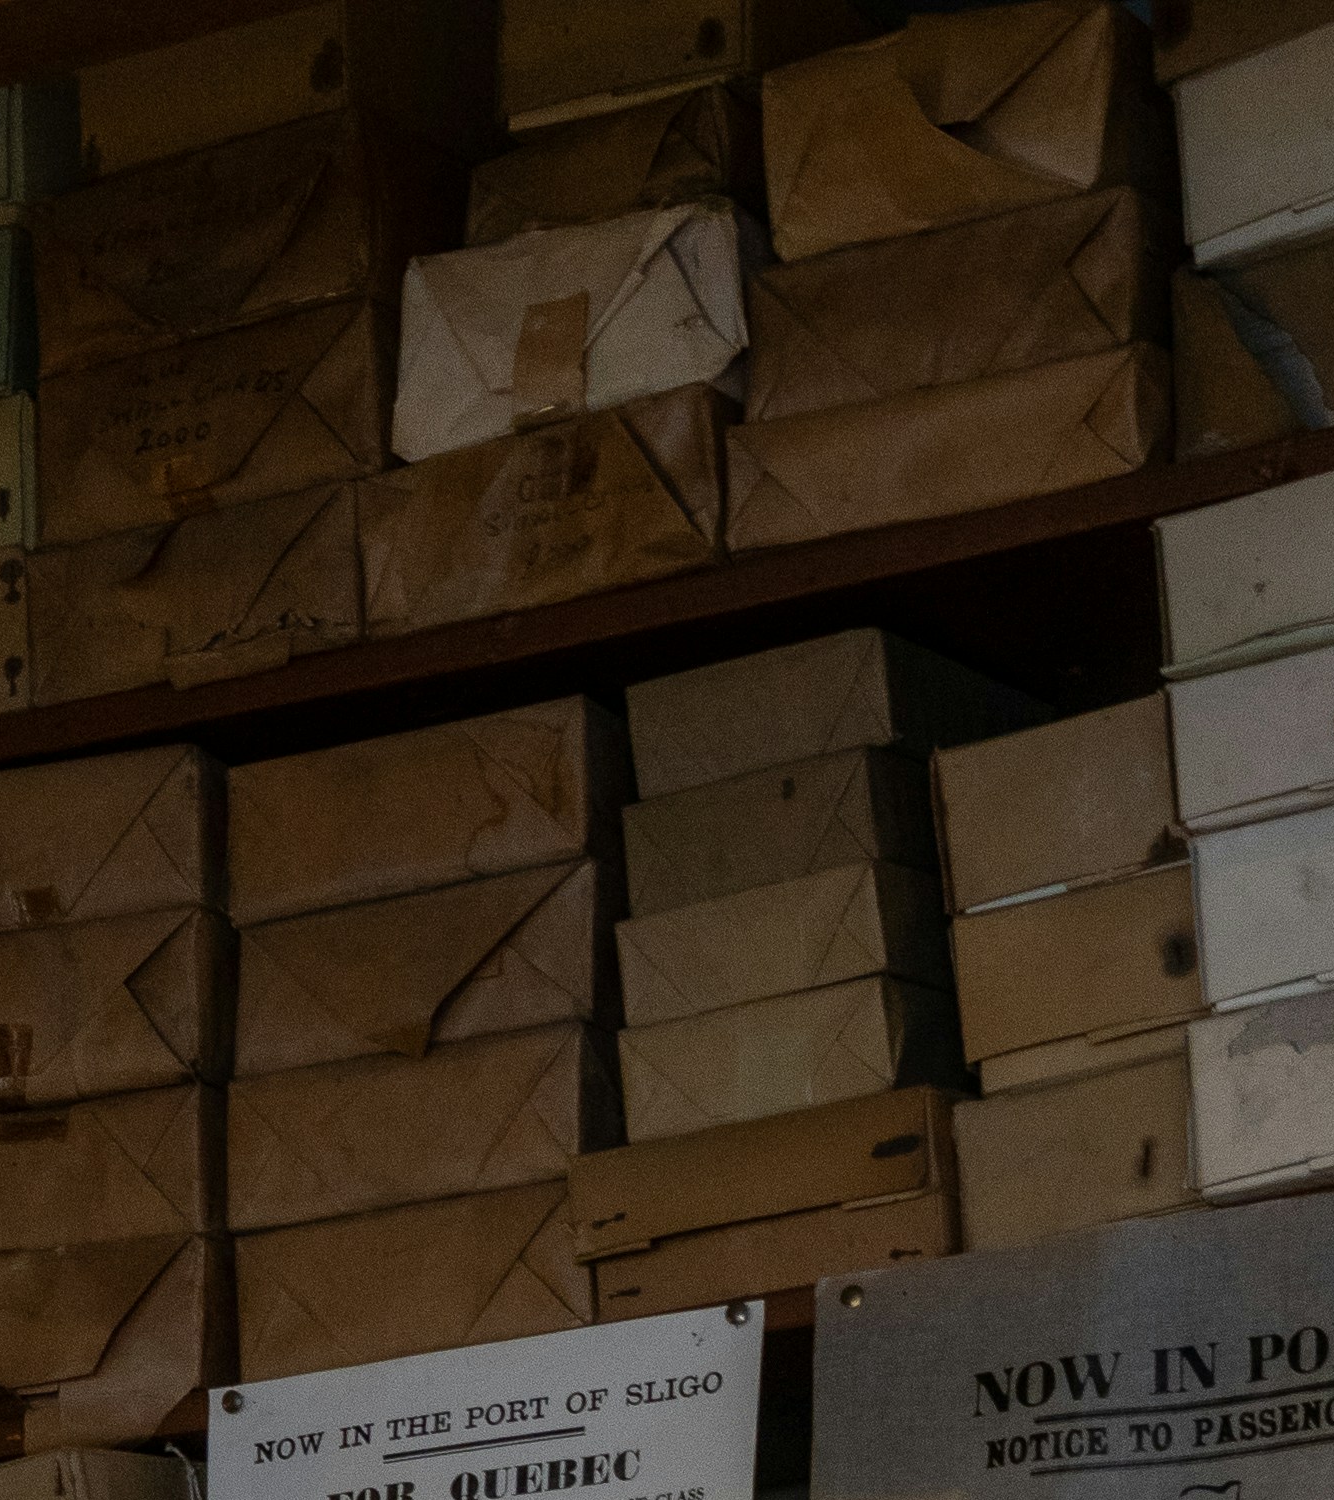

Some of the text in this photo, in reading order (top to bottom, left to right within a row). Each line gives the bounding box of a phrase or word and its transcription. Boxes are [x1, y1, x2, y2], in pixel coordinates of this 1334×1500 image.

[135, 421, 211, 456] 2000
[972, 1350, 1121, 1418] NOW
[1152, 1341, 1218, 1395] IN
[253, 1370, 723, 1465] NOW IN THE PORT OF SLIGO
[985, 1426, 1108, 1469] NOTICE
[1127, 1420, 1173, 1453] TO
